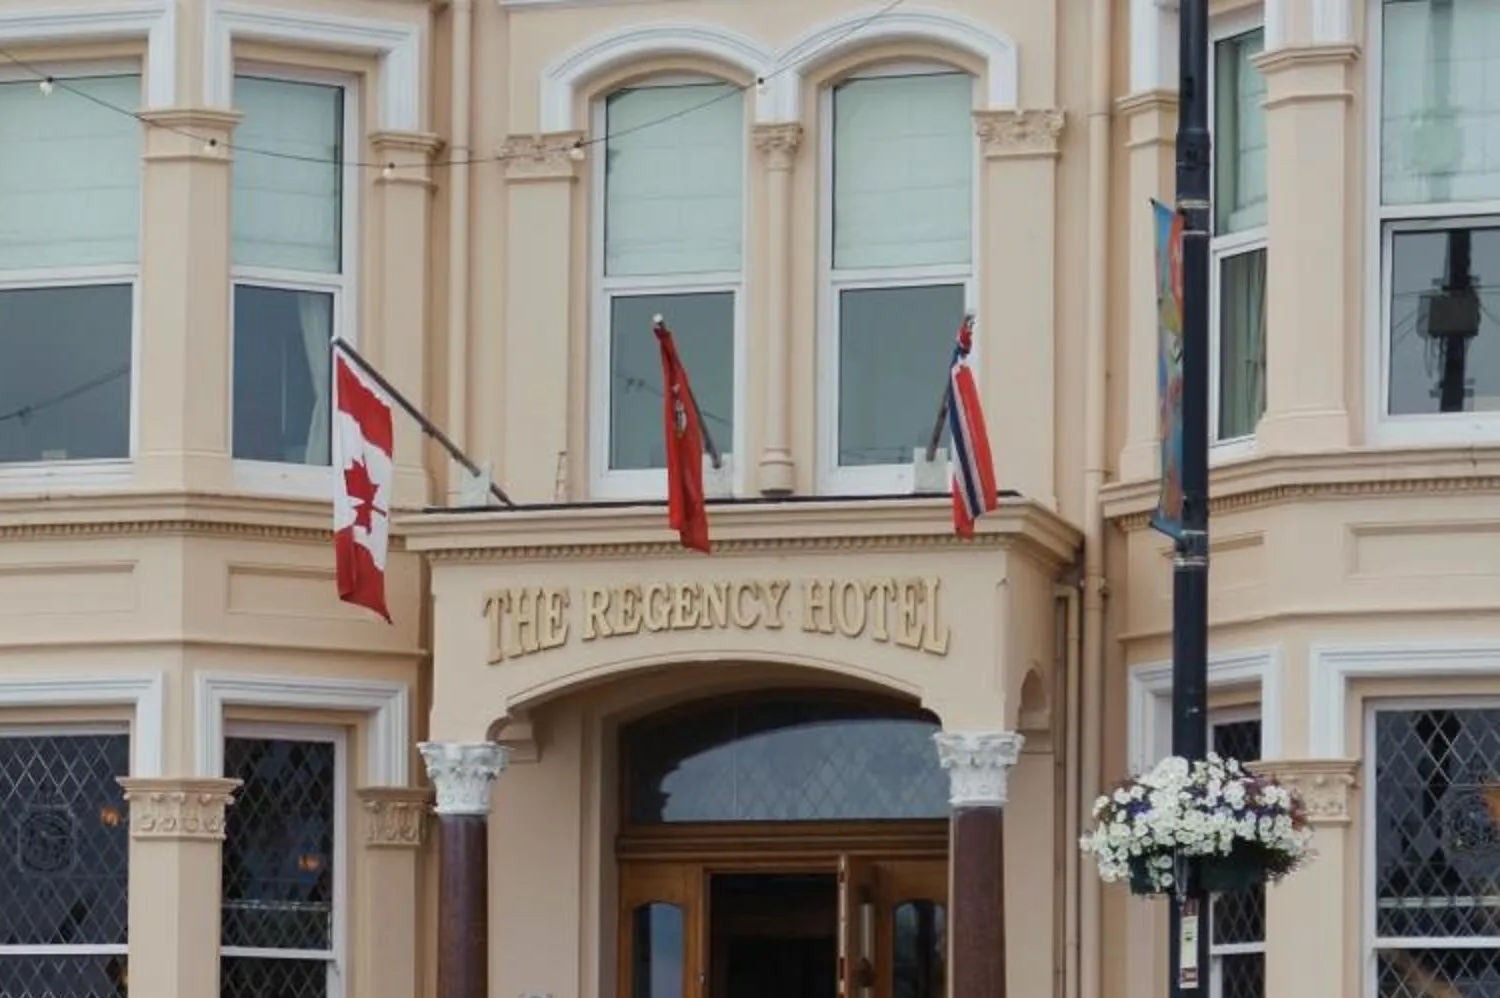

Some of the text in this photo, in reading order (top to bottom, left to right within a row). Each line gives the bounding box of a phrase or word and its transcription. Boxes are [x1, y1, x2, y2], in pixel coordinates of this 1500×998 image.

[482, 576, 950, 664] THE REGENCY HOTEL
